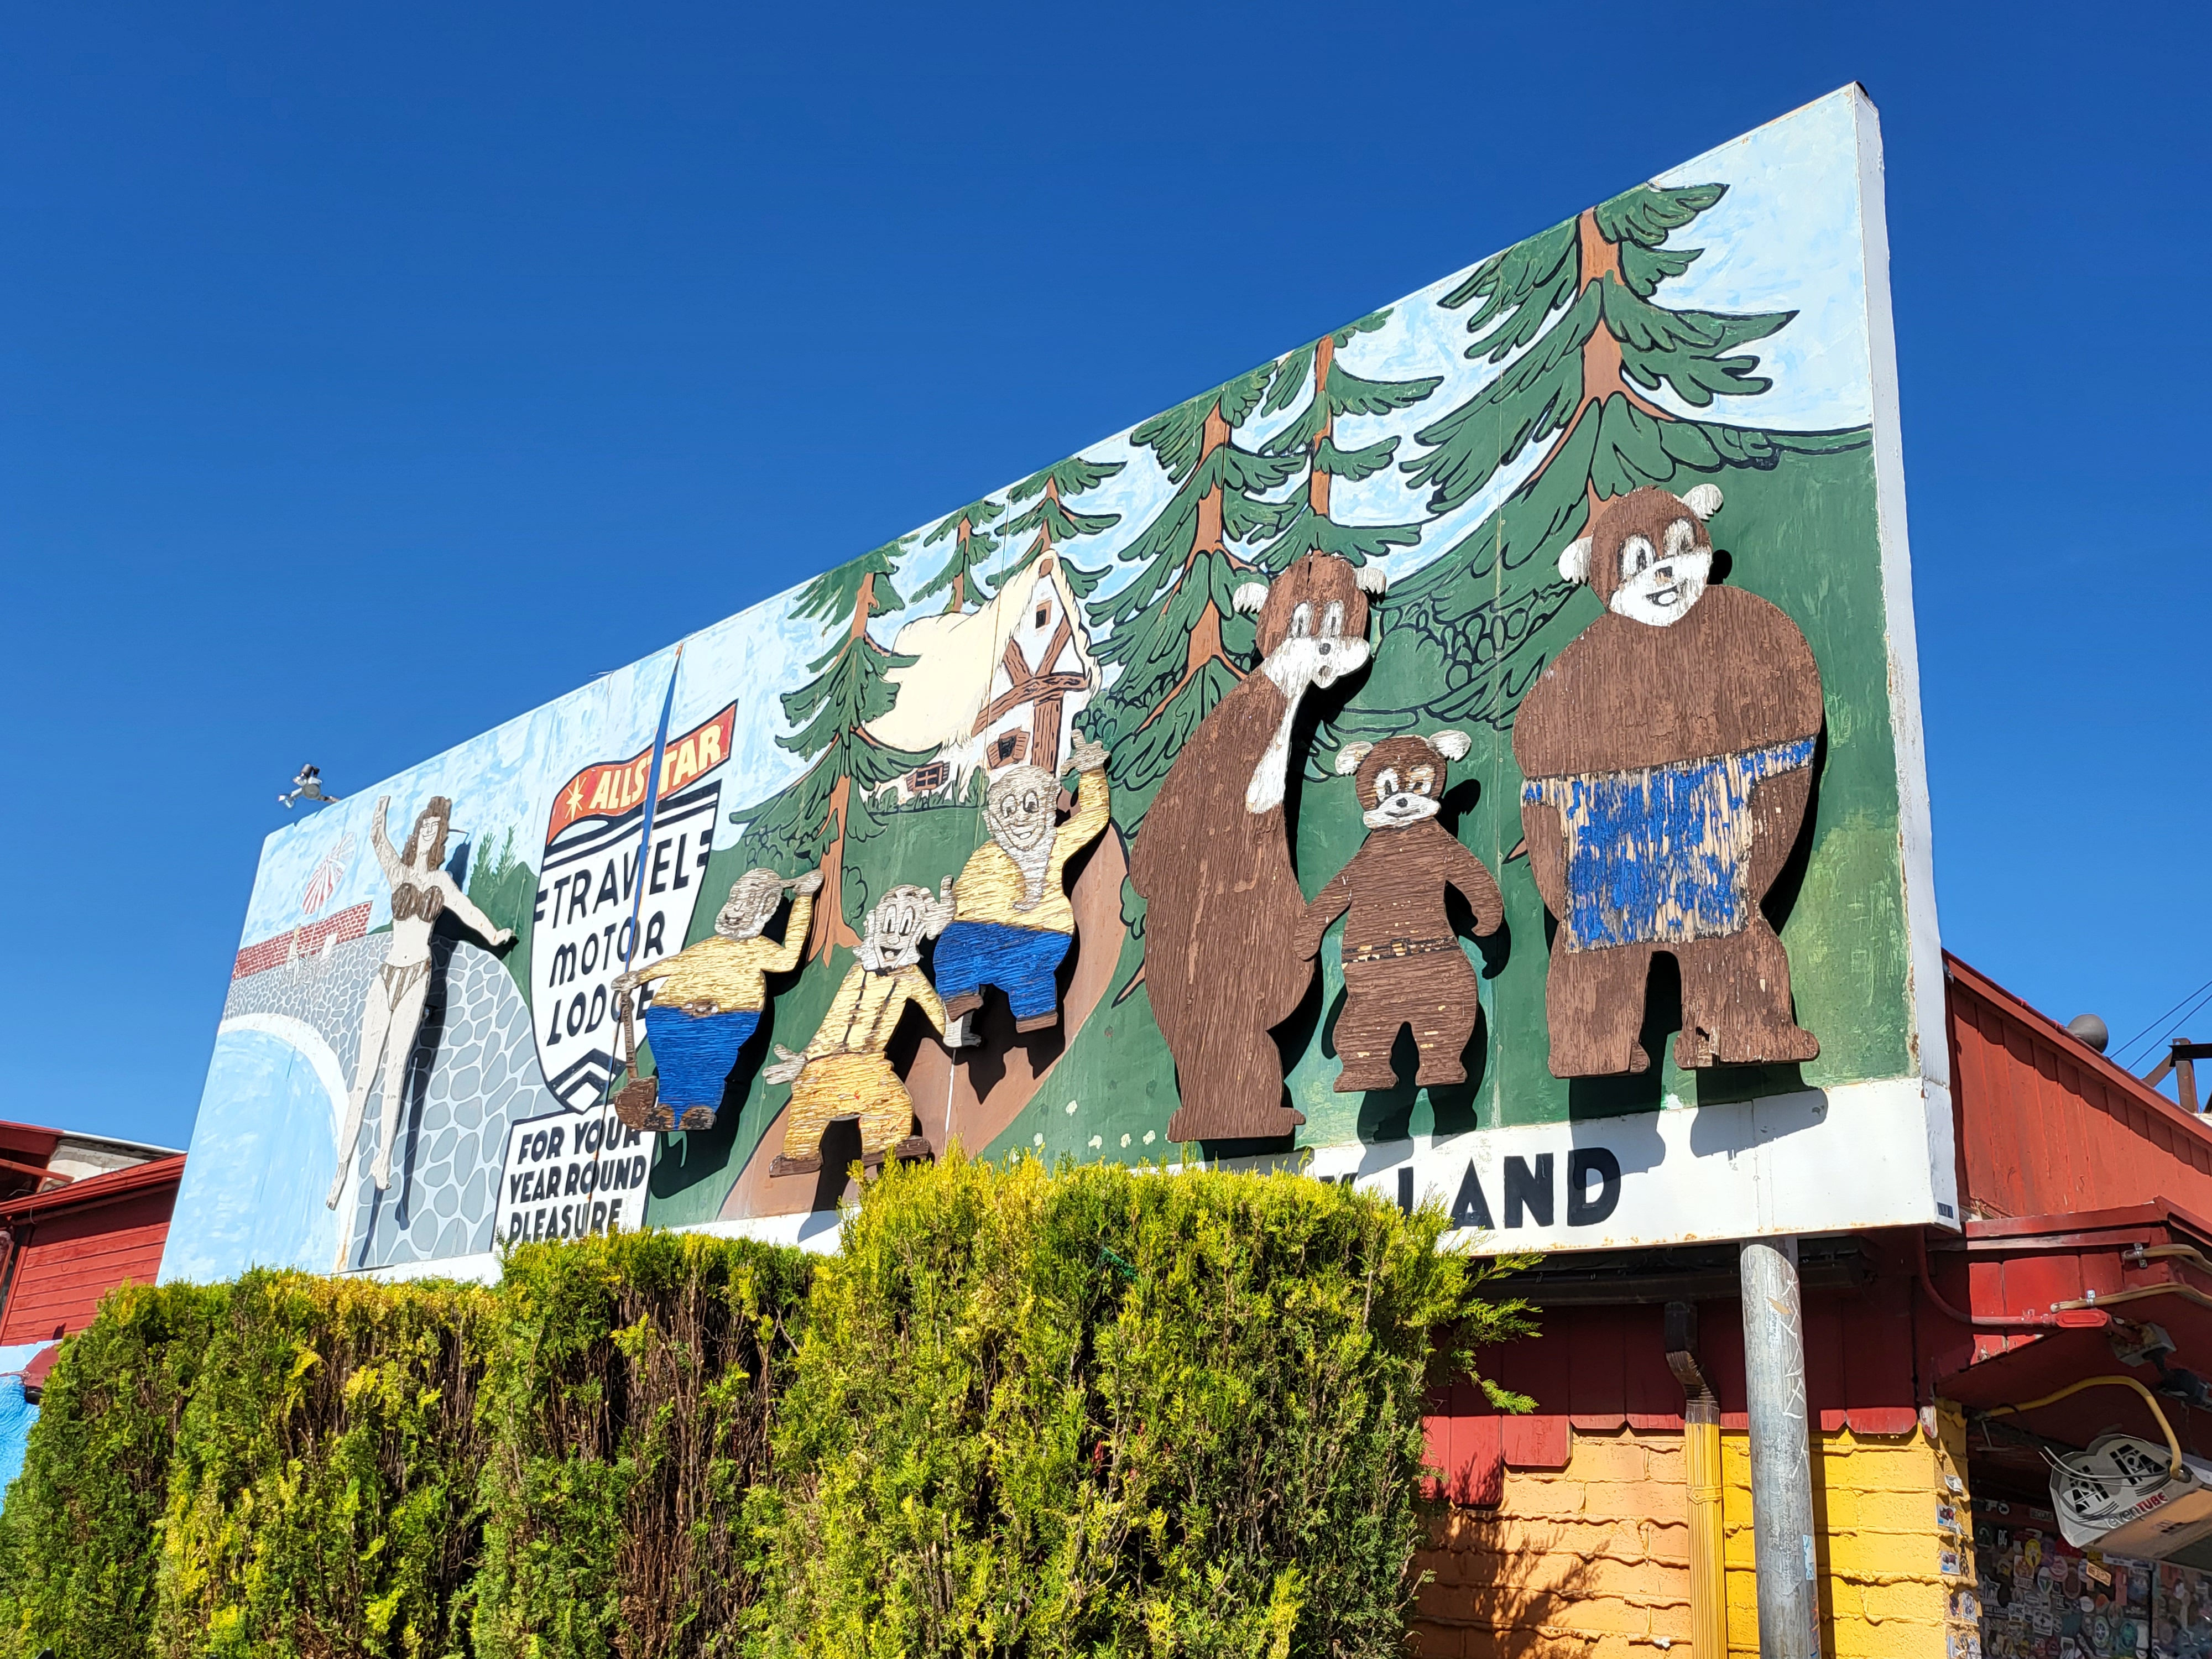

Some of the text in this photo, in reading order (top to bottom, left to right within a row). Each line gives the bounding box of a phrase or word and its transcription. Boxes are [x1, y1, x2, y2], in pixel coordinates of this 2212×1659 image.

[552, 833, 690, 929] TRAVEL
[518, 1126, 565, 1165] FOR
[510, 1155, 646, 1204] YEAR ROUND
[509, 1198, 623, 1243] PLEASURE
